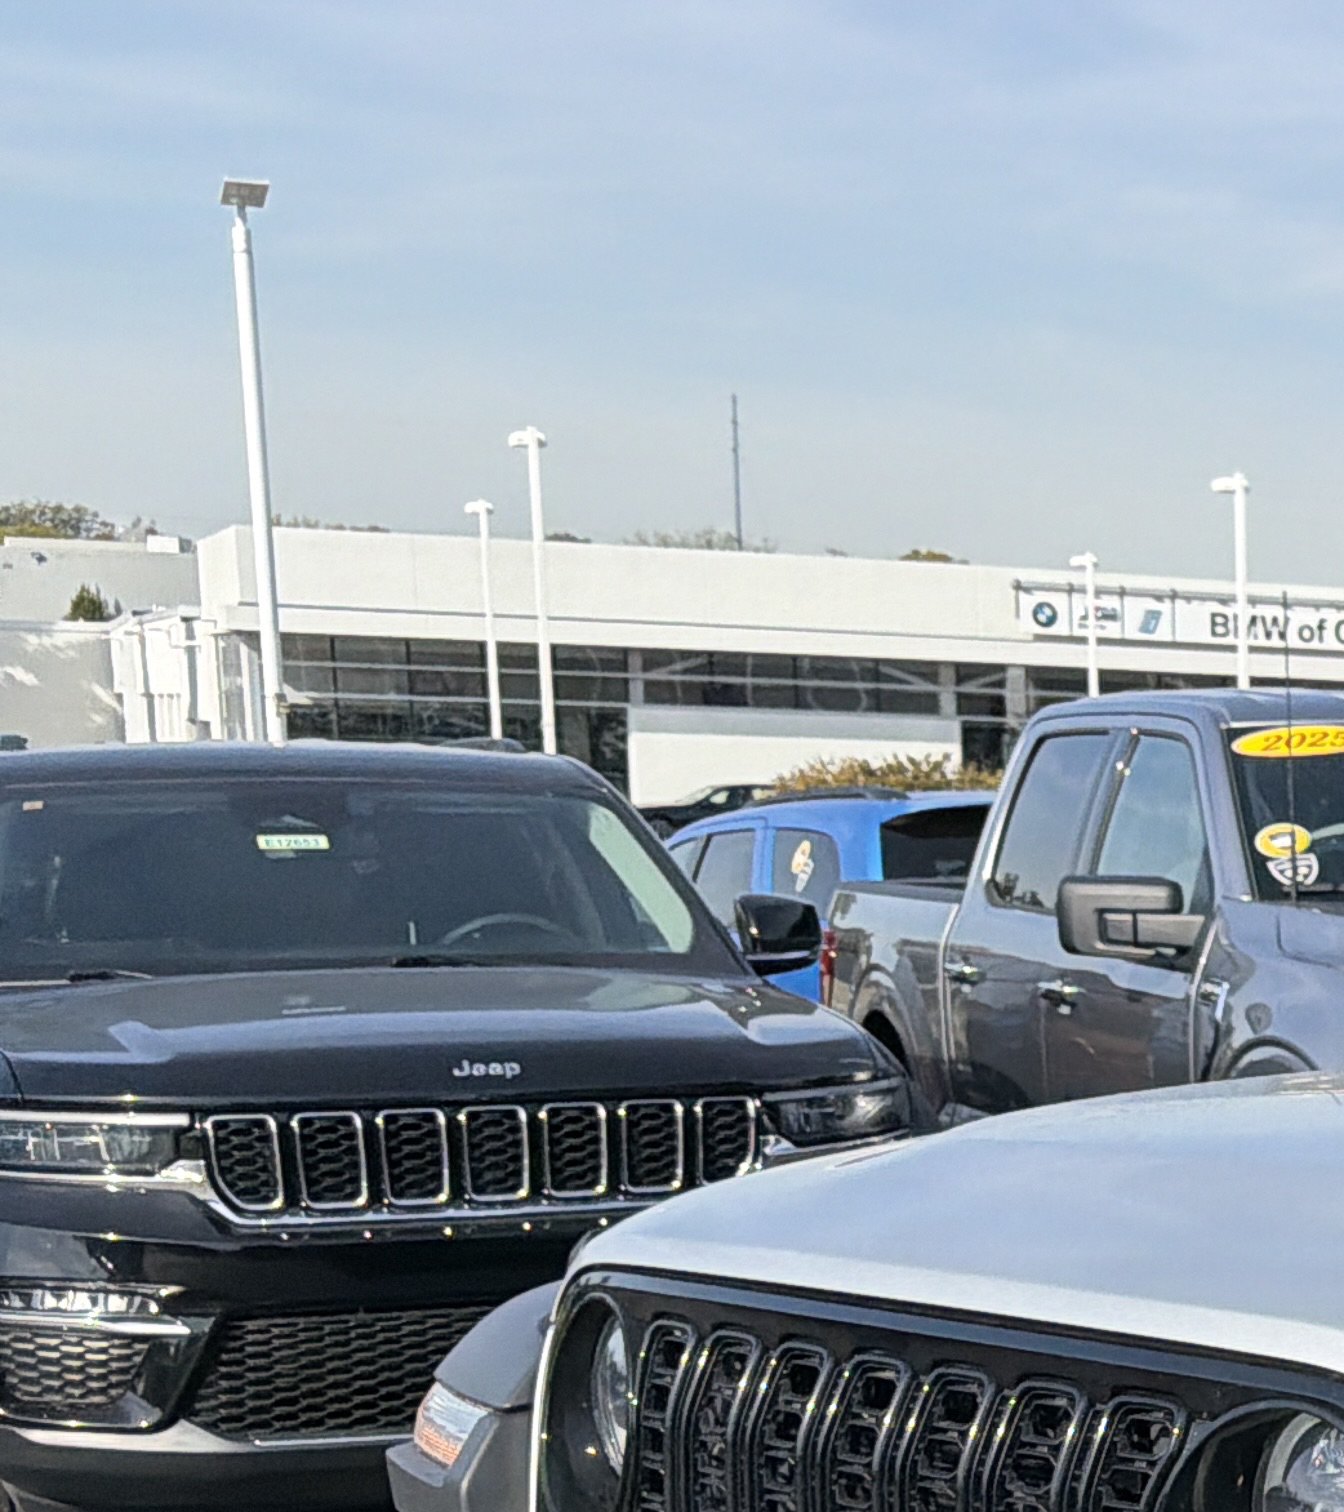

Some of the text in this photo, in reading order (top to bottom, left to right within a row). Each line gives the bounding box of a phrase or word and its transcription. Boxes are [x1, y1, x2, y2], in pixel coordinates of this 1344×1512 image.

[1210, 612, 1290, 641] BMW
[1299, 618, 1327, 643] of
[452, 1059, 521, 1080] Jeep
